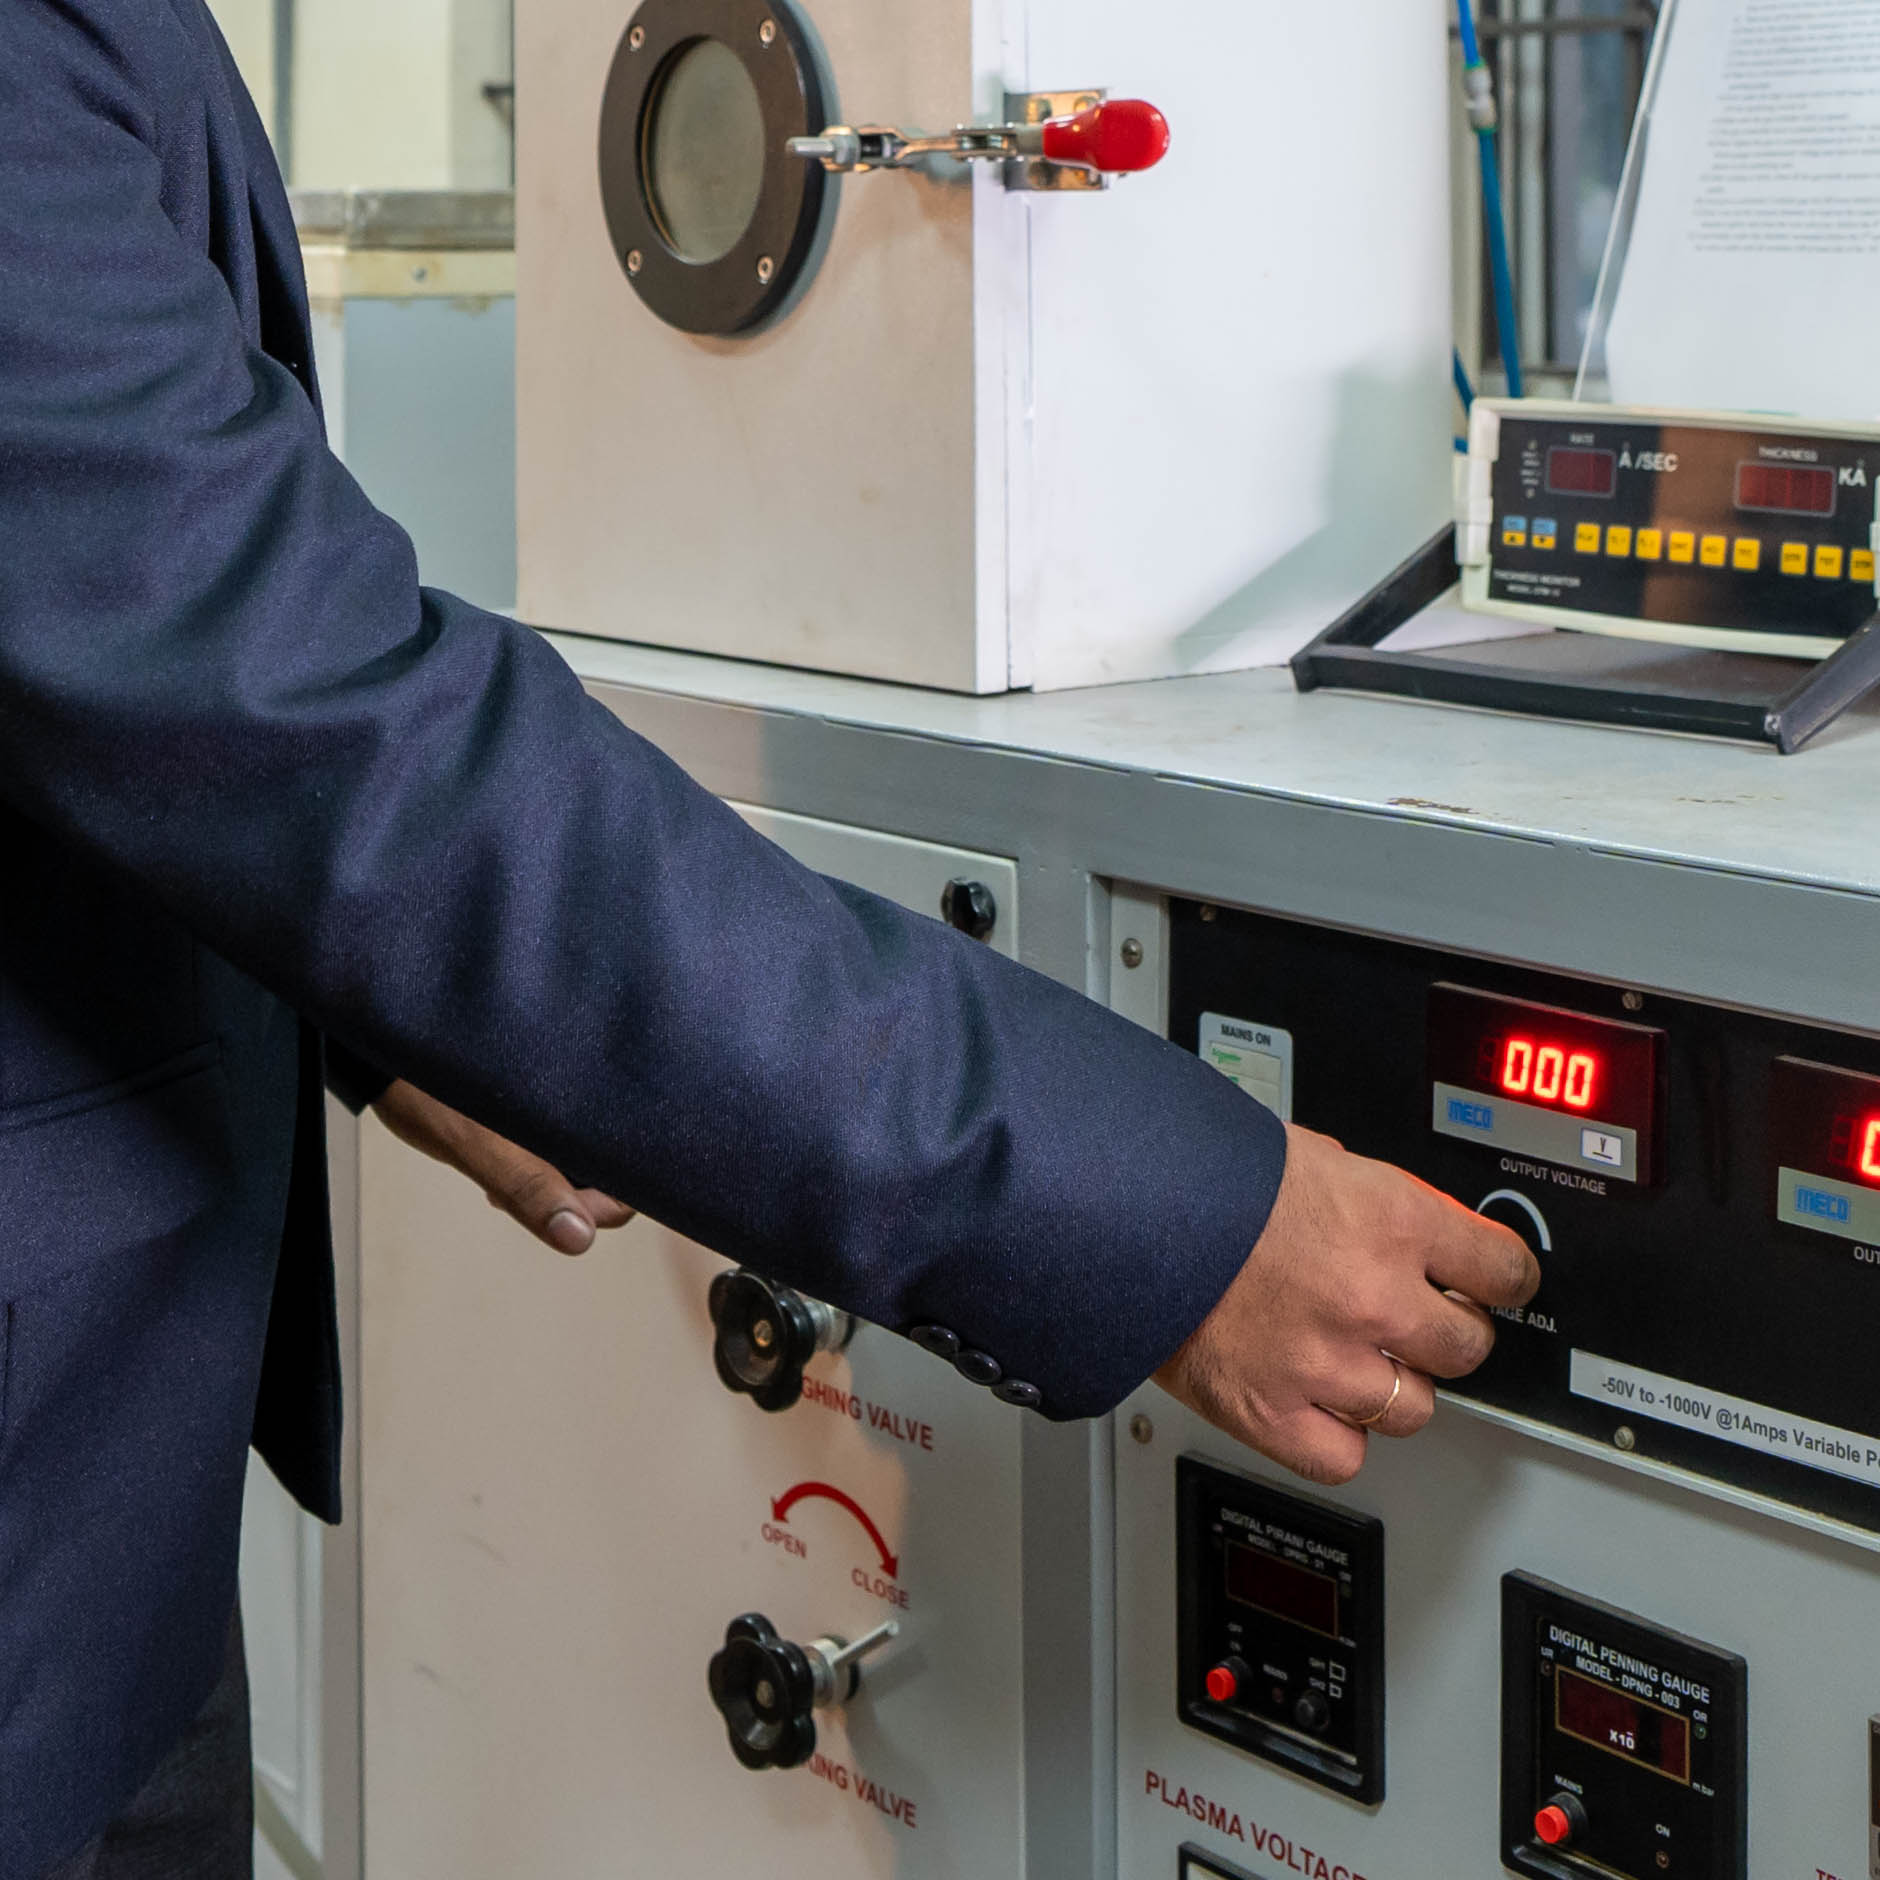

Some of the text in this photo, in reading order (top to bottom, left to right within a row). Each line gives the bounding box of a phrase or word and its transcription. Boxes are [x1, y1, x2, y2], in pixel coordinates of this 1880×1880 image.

[1221, 1023, 1271, 1047] MAINS ON
[1502, 1039, 1595, 1107] 000
[1447, 1097, 1493, 1131] MECO
[1500, 1157, 1607, 1196] OUTPUT VOLTAGE
[1794, 1184, 1851, 1225] MECO
[1526, 1312, 1558, 1334] ADJ.
[801, 1375, 934, 1452] GHING VALVE
[1601, 1375, 1637, 1399] -50V
[1638, 1386, 1656, 1405] to
[1658, 1392, 1713, 1421] -1000V
[1716, 1408, 1789, 1443] @1Amps
[1791, 1428, 1862, 1465] Variable
[760, 1522, 808, 1559] OPEN
[1221, 1507, 1350, 1567] DIGITAL PIRANI GAUGE
[850, 1567, 911, 1611] CLOSE
[1549, 1624, 1711, 1705] DIGITAL PENNING GAUGE
[1575, 1655, 1614, 1683] MODEL
[1621, 1675, 1654, 1699] DPNG
[1660, 1690, 1681, 1710] 003
[1692, 1708, 1709, 1723] OR
[852, 1773, 917, 1830] VALVE
[1554, 1773, 1584, 1796] MAINS
[1144, 1769, 1246, 1844] PLASMA
[1655, 1822, 1671, 1838] ON
